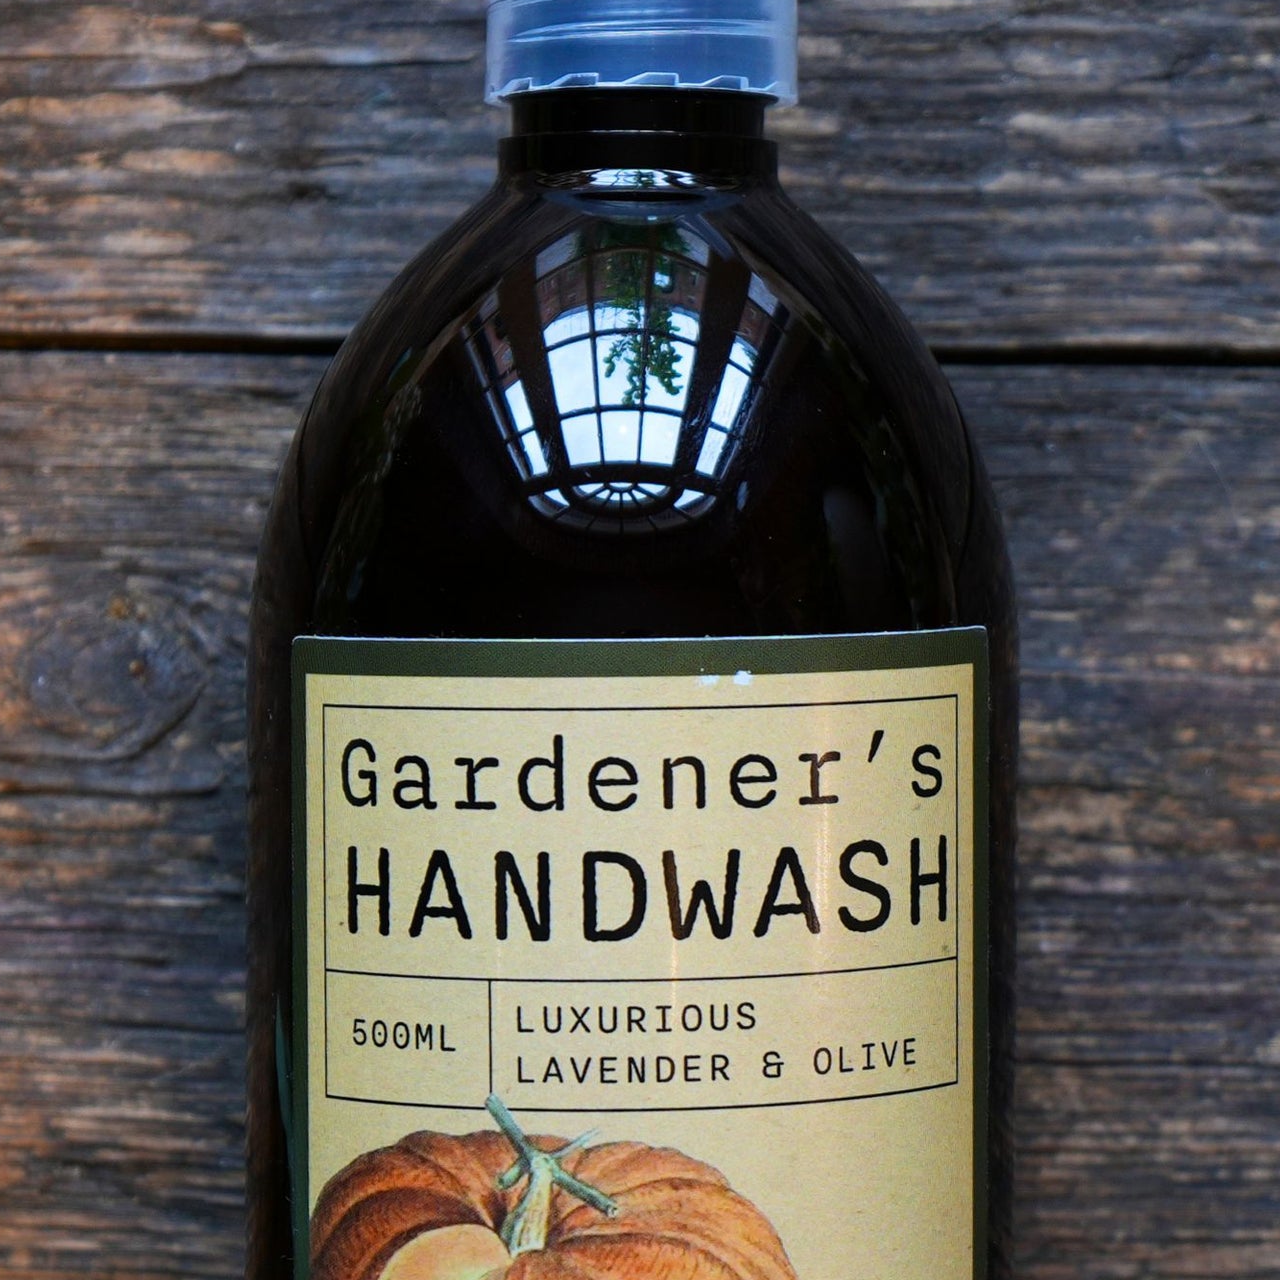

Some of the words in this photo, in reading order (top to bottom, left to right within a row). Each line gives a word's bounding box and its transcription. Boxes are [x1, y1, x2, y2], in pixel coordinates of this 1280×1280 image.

[341, 730, 942, 811] Gardener's
[348, 835, 947, 942] HANDWASH
[353, 1019, 455, 1051] 500ML
[517, 1002, 755, 1033] LUXURIOUS
[518, 1055, 729, 1083] LAVENDER
[763, 1051, 784, 1078] &
[814, 1038, 915, 1074] OLIVE
